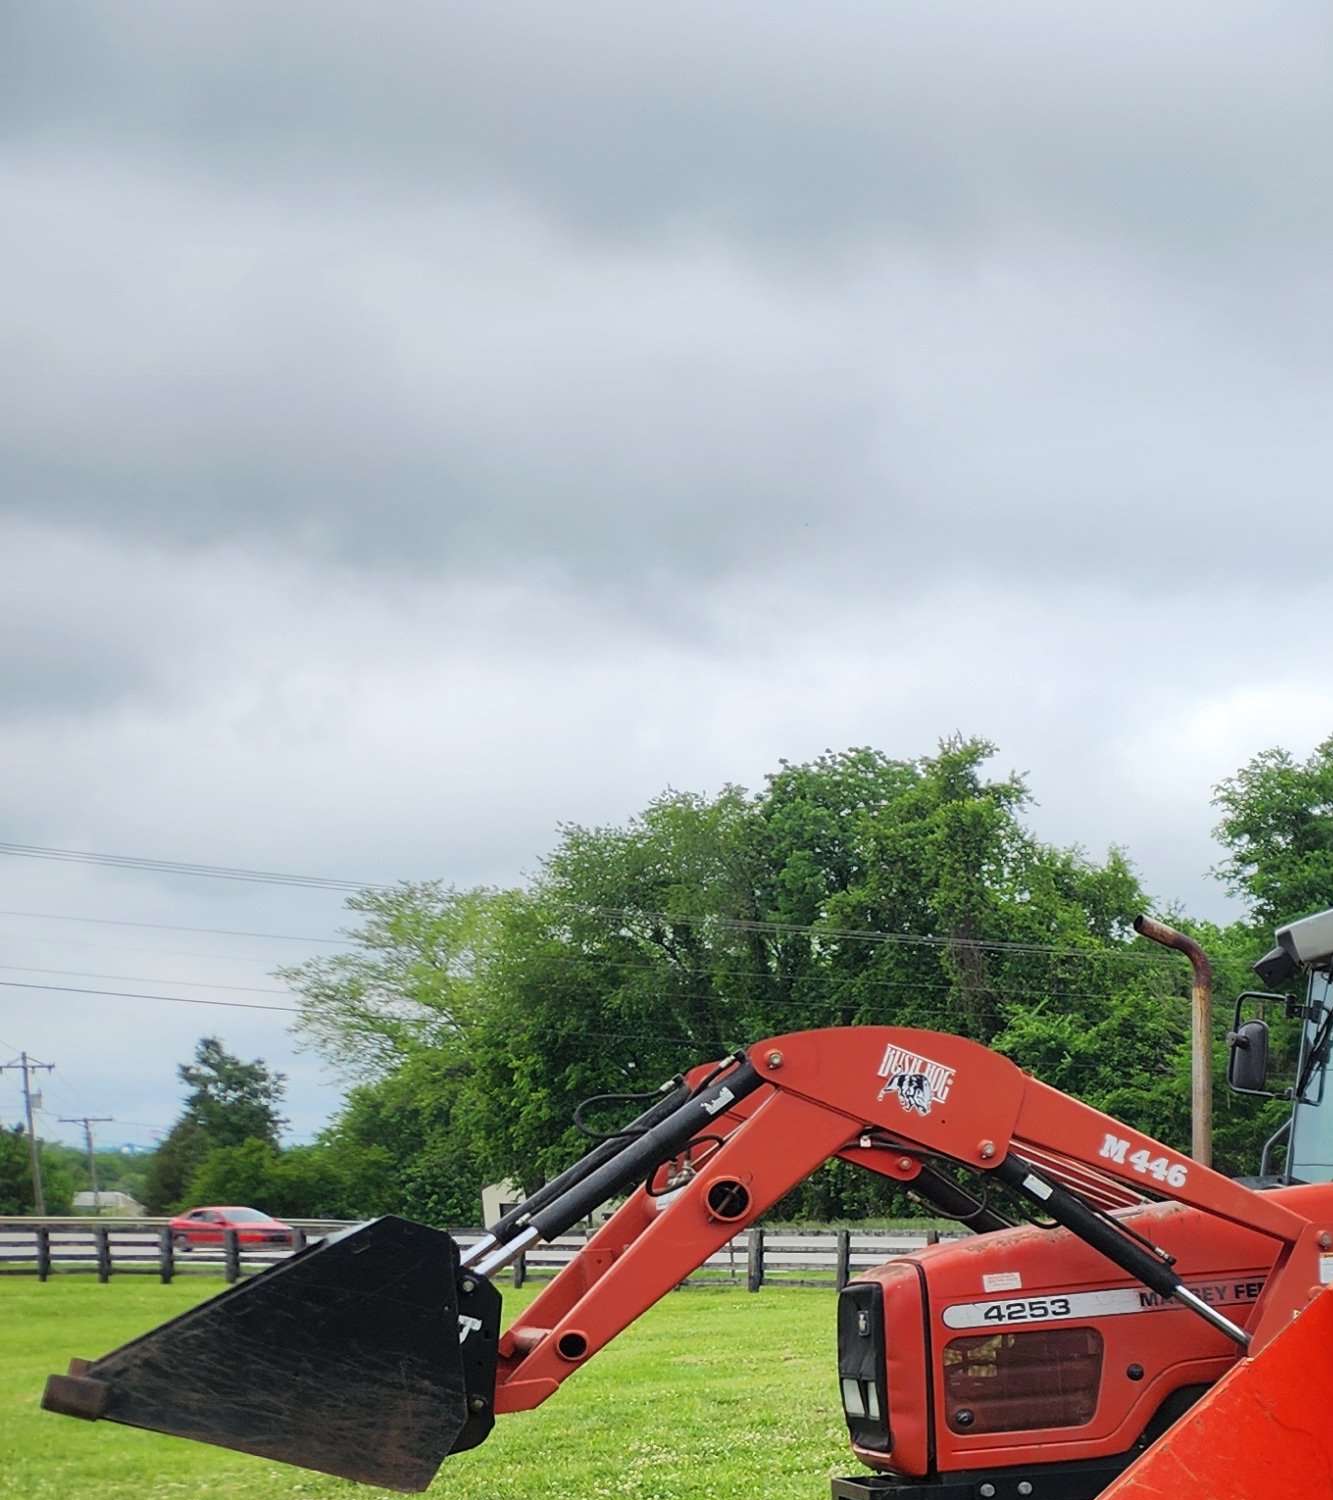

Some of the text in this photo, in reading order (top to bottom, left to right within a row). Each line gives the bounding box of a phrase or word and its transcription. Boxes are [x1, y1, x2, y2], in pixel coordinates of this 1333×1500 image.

[878, 1046, 955, 1102] BUSH HOG
[1099, 1133, 1188, 1188] M 446
[983, 1299, 1072, 1322] 4253
